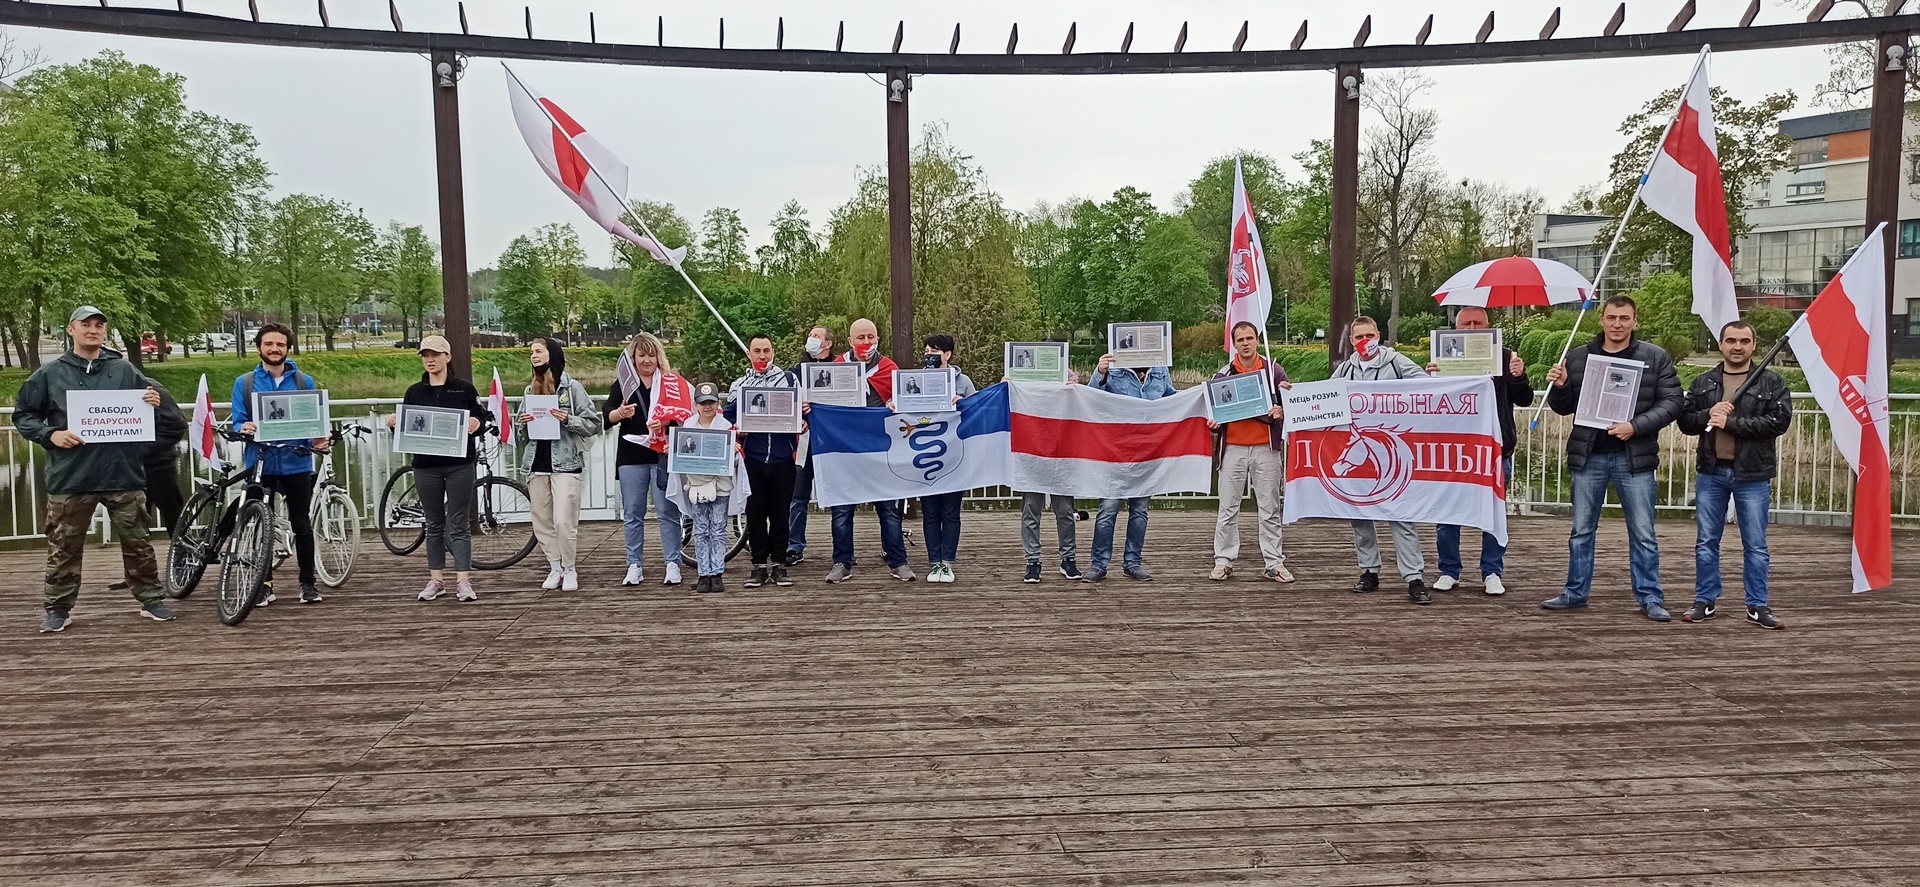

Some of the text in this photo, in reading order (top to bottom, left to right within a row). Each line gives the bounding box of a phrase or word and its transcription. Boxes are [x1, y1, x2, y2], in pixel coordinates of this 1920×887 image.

[1289, 396, 1311, 404] МЕЦЬ
[1347, 393, 1478, 414] ОЛЬНАЯ
[88, 406, 134, 415] СВАБОДУ
[81, 417, 142, 426] БЕЛАРУСКІМ
[1291, 411, 1344, 424] ЗЛАЧЫНСТВА!
[80, 428, 143, 438] СТУДЭНТАМ!
